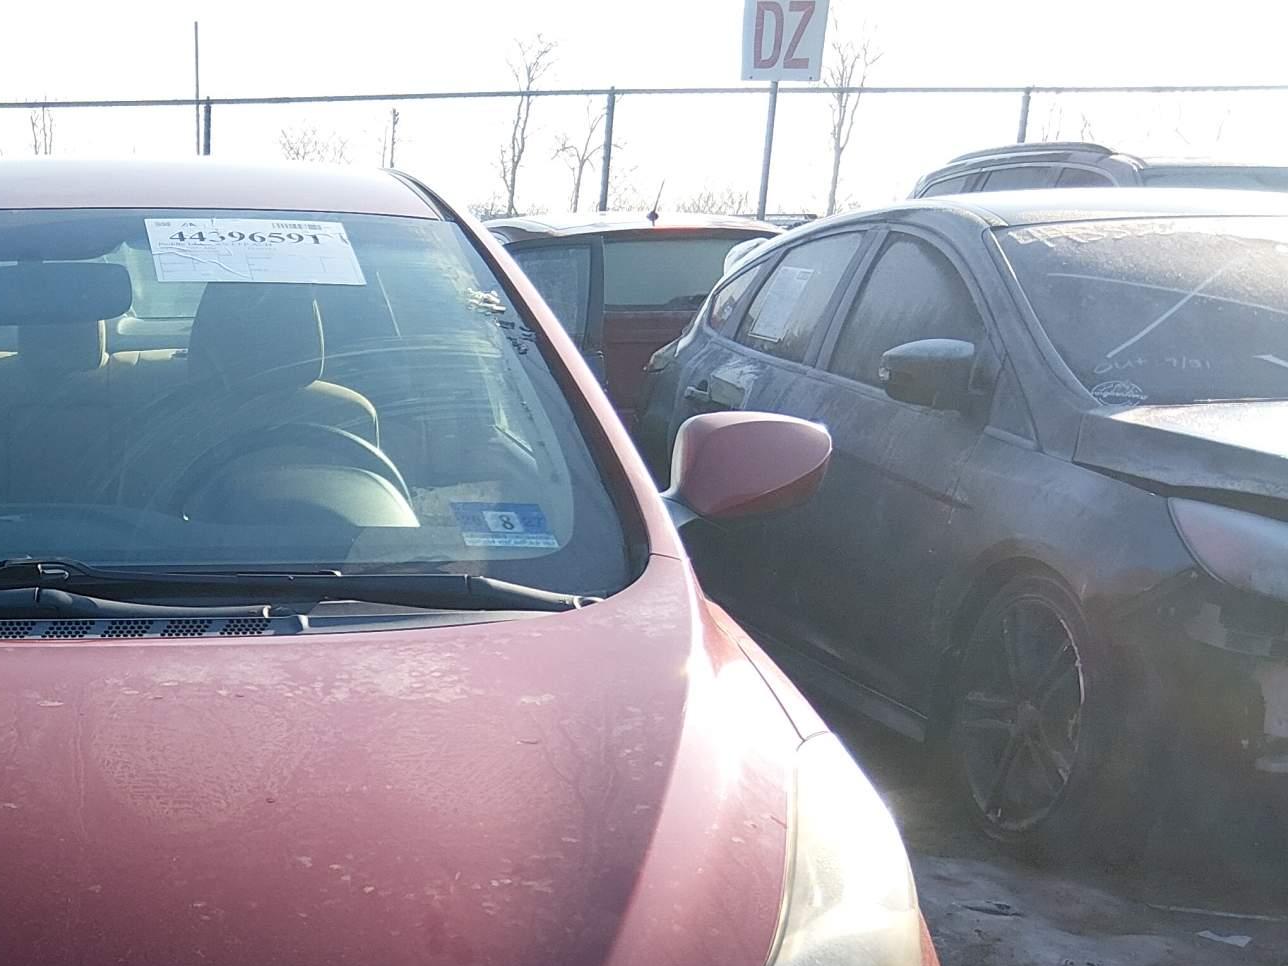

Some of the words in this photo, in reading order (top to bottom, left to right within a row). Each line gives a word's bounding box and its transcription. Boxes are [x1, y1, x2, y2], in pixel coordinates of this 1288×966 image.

[753, 0, 816, 69] DZ
[169, 230, 321, 245] 44396591
[498, 514, 515, 530] 8
